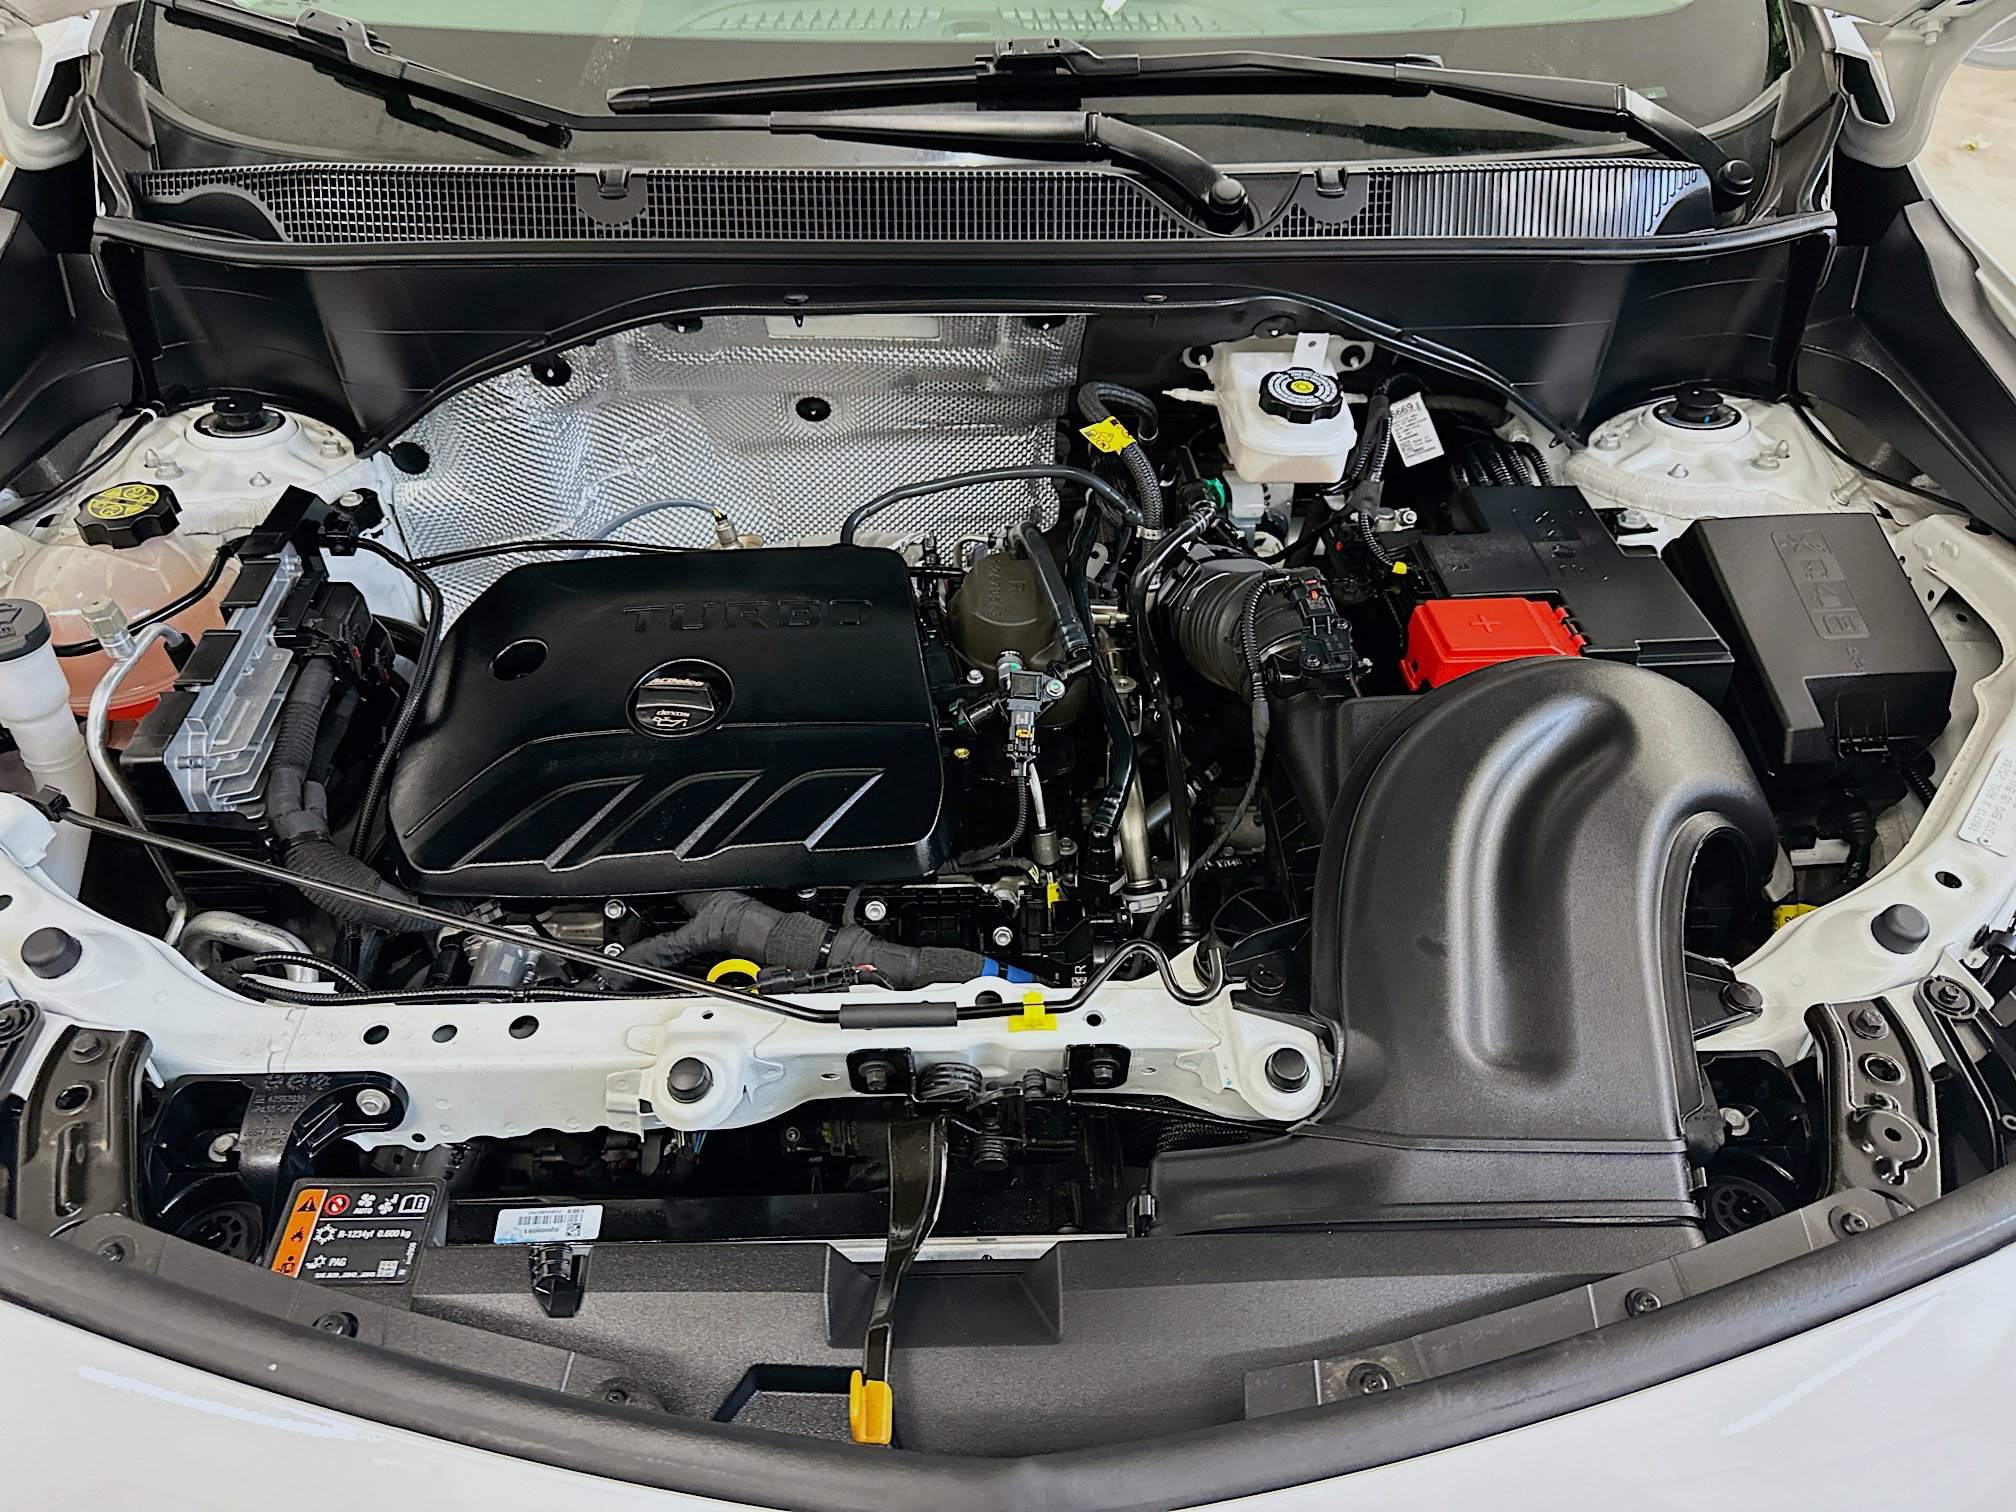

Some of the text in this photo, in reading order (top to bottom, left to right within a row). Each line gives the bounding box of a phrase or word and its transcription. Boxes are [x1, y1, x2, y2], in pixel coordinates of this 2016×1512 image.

[623, 600, 872, 634] TURBO
[656, 709, 690, 717] dexos
[353, 1207, 374, 1215] AUTO
[337, 1229, 412, 1240] R-1234yf 0.600 kg
[328, 1257, 348, 1267] PAG
